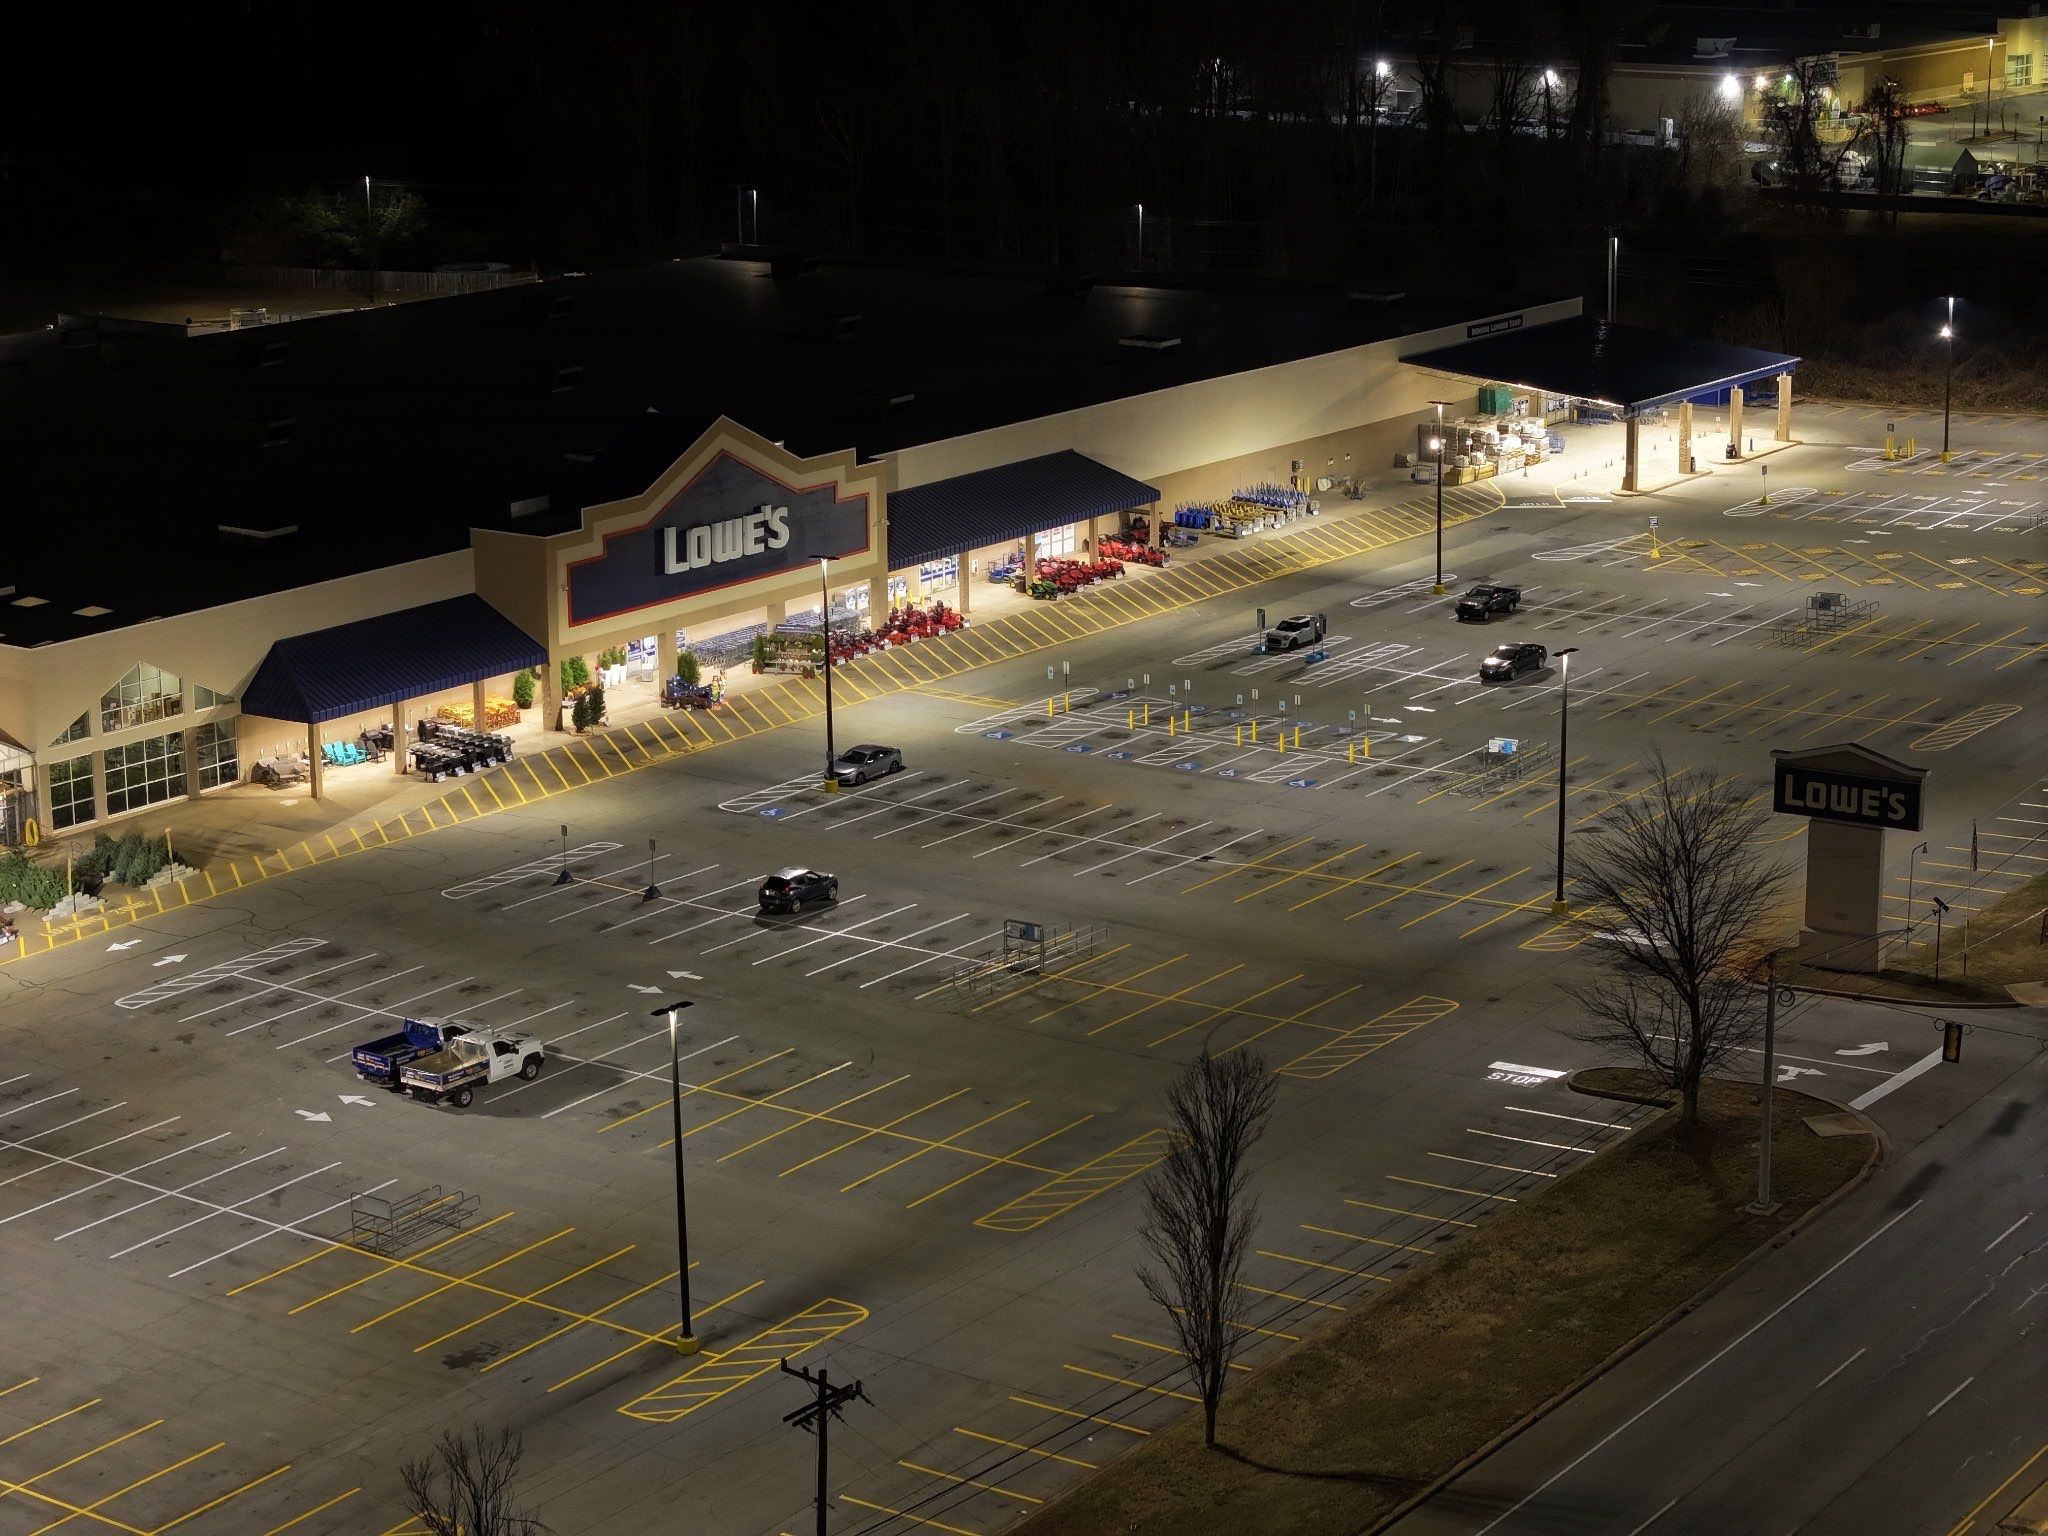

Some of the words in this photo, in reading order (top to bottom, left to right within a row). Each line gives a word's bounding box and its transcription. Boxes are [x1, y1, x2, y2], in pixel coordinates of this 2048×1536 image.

[663, 503, 790, 575] LOWE'S
[1783, 773, 1907, 822] LOWE'S
[1487, 1072, 1543, 1084] STOP
